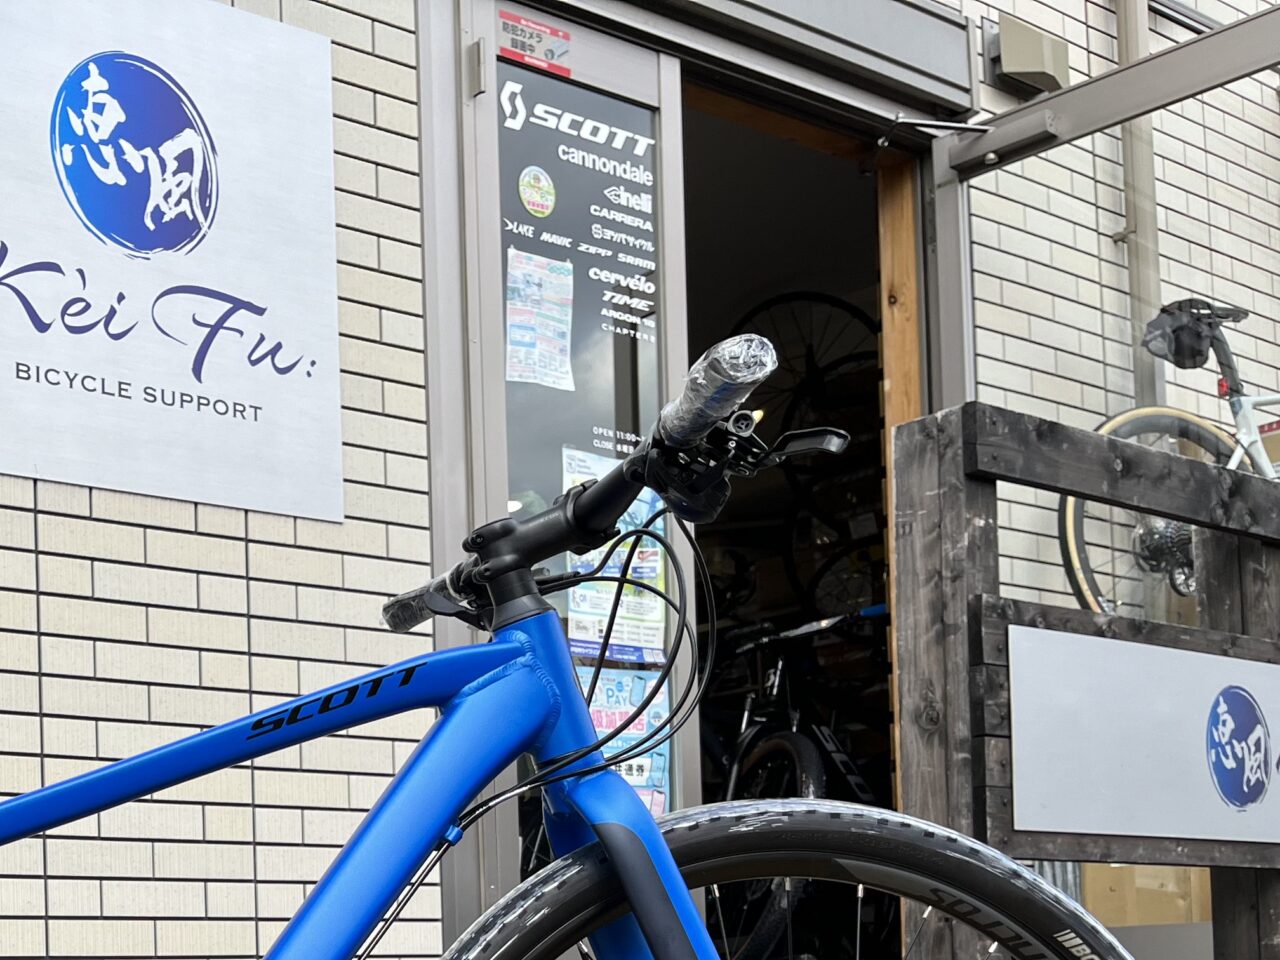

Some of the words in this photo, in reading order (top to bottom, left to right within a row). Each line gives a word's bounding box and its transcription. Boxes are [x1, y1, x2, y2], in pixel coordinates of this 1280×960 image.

[529, 103, 655, 156] SCOTT
[558, 144, 653, 186] cannondale
[590, 204, 653, 232] CARRERA
[513, 221, 535, 237] LAKE
[540, 231, 573, 248] MAVIC
[617, 253, 656, 270] SRAM
[588, 267, 656, 294] cervélo
[602, 290, 655, 311] TIME
[601, 308, 641, 325] ARGON
[15, 361, 132, 399] BICYCLE
[143, 386, 263, 422] SUPPORT
[592, 426, 614, 437] OPEN
[593, 439, 614, 450] CLOSE
[246, 661, 428, 741] SCOTT
